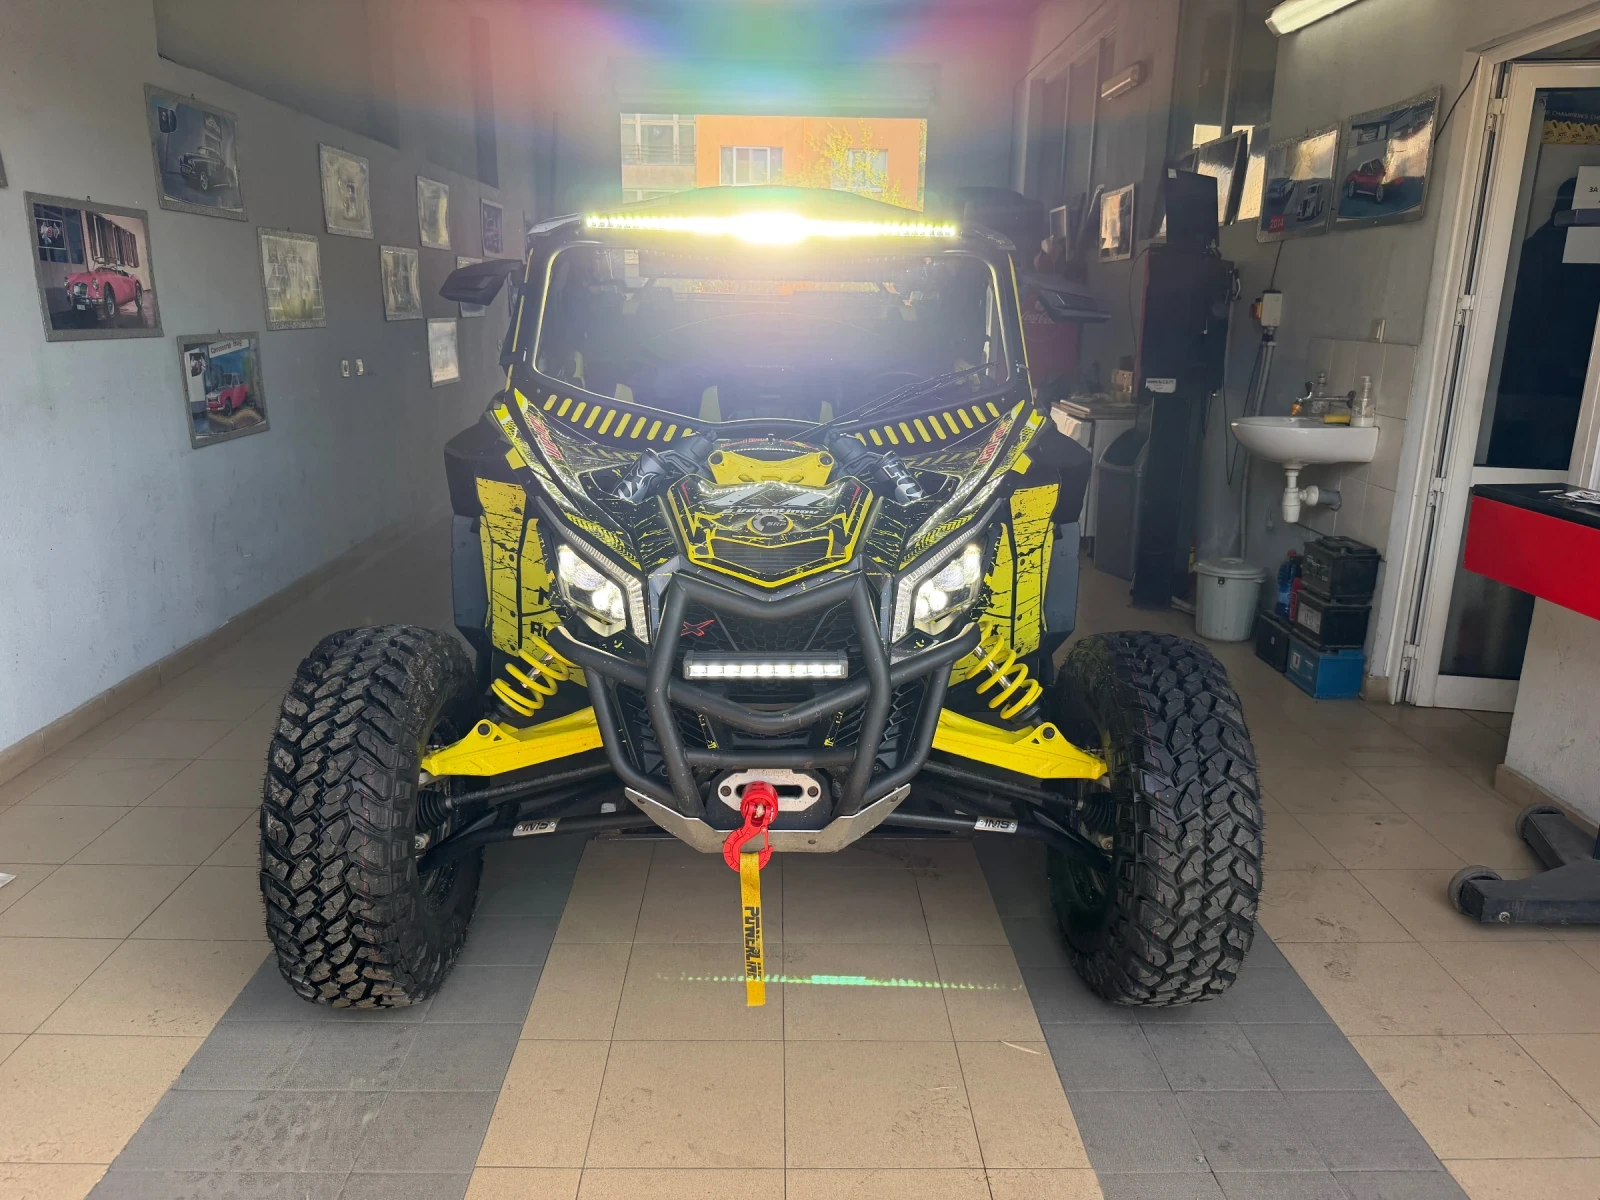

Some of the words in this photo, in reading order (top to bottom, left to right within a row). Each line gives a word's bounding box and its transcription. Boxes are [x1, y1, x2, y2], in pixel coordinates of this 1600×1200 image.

[1270, 216, 1284, 229] 2014
[522, 820, 550, 832] IMS
[984, 818, 1011, 829] IMS
